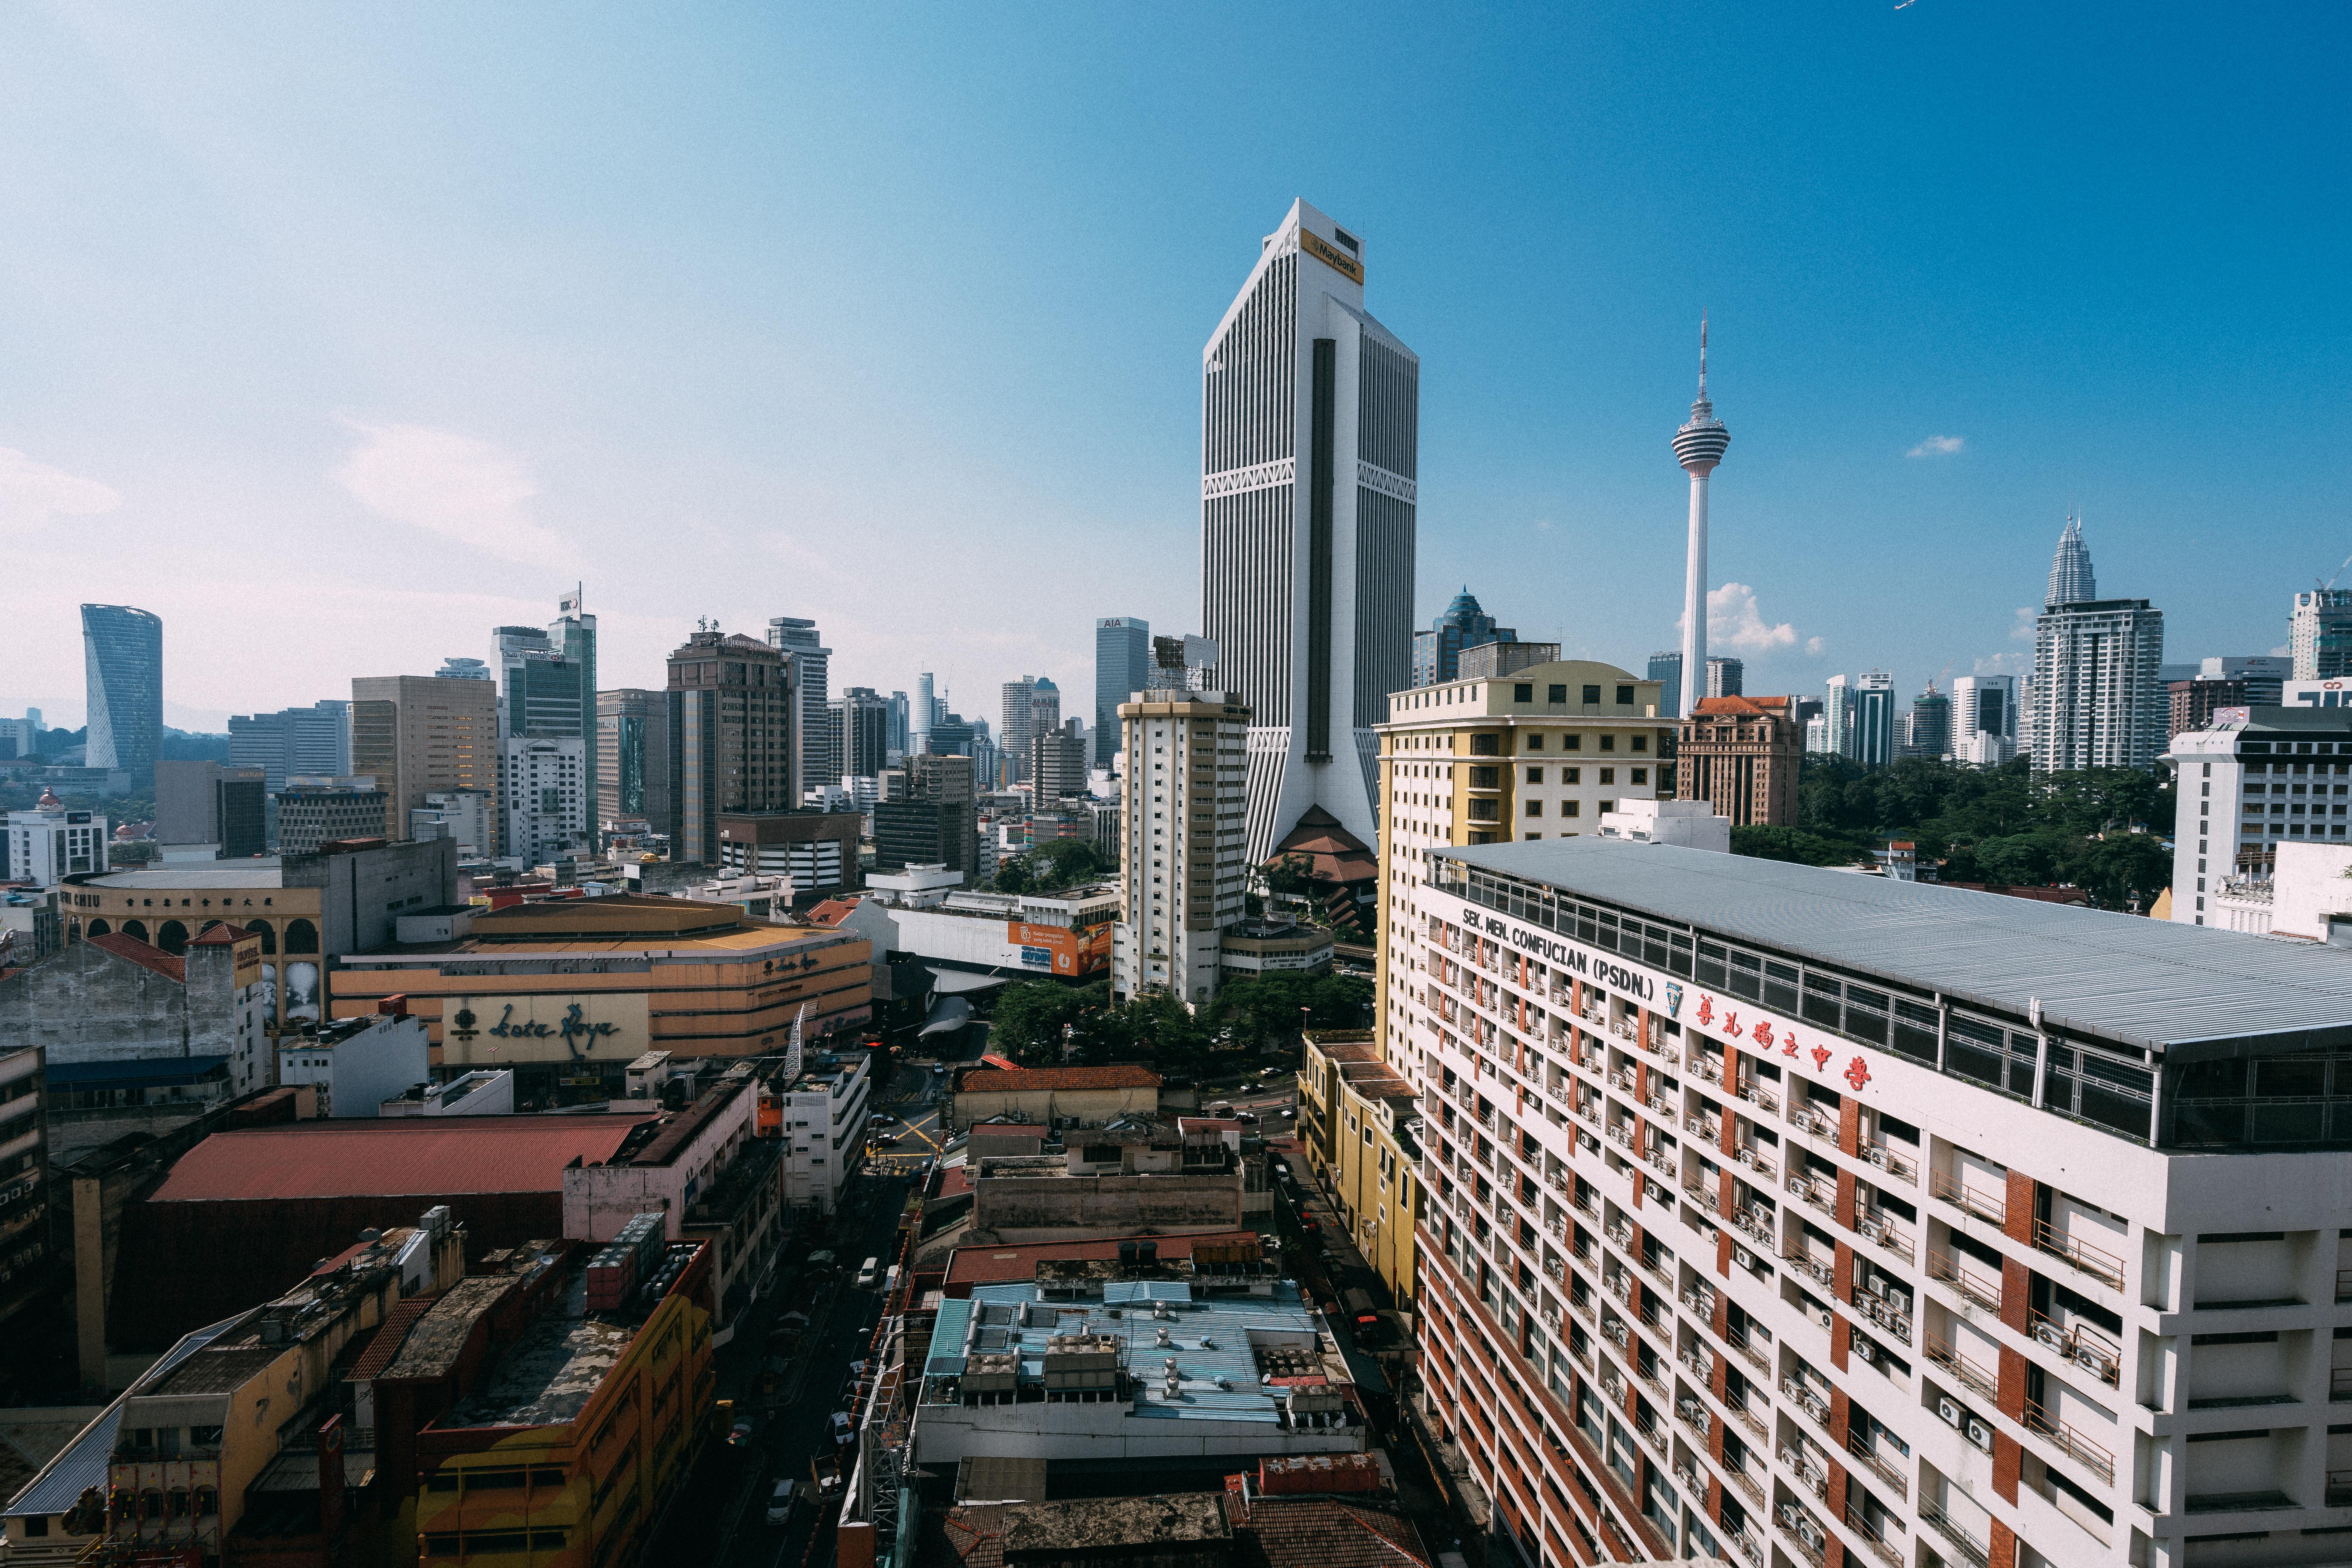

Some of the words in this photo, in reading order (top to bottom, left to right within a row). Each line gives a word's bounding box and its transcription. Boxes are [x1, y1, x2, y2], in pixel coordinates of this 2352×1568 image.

[1319, 243, 1357, 277] Maybank
[561, 599, 572, 612] HSBC
[1104, 619, 1122, 628] AIA
[74, 894, 100, 908] CHIU
[1463, 908, 1483, 930] SEK.
[1485, 916, 1509, 942] MEN.
[1512, 927, 1588, 974] CONFUCIAN
[1593, 958, 1654, 1001] (PSDN.)
